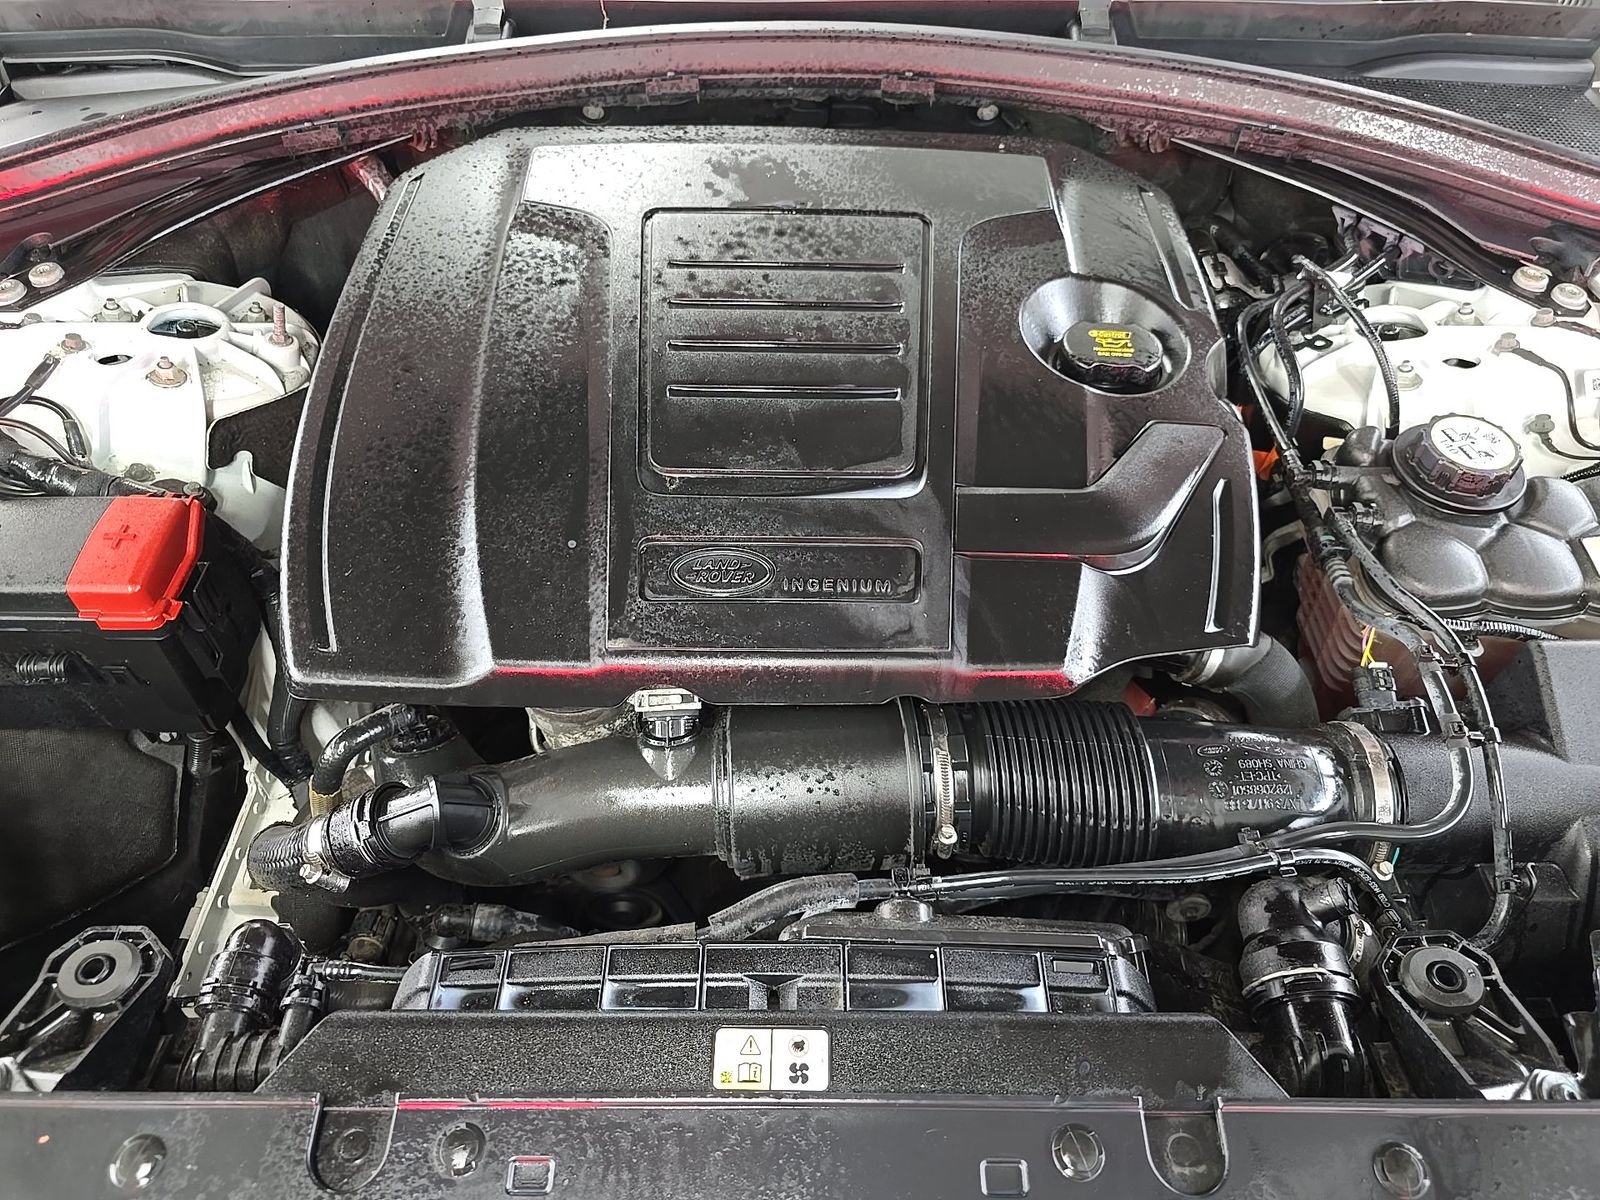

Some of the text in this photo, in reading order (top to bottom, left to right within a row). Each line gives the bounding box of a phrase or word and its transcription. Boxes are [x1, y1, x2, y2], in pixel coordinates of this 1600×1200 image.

[692, 558, 741, 570] LAND
[695, 570, 755, 584] ROVER
[782, 577, 893, 594] INGENIUM
[1277, 758, 1307, 770] CHINA
